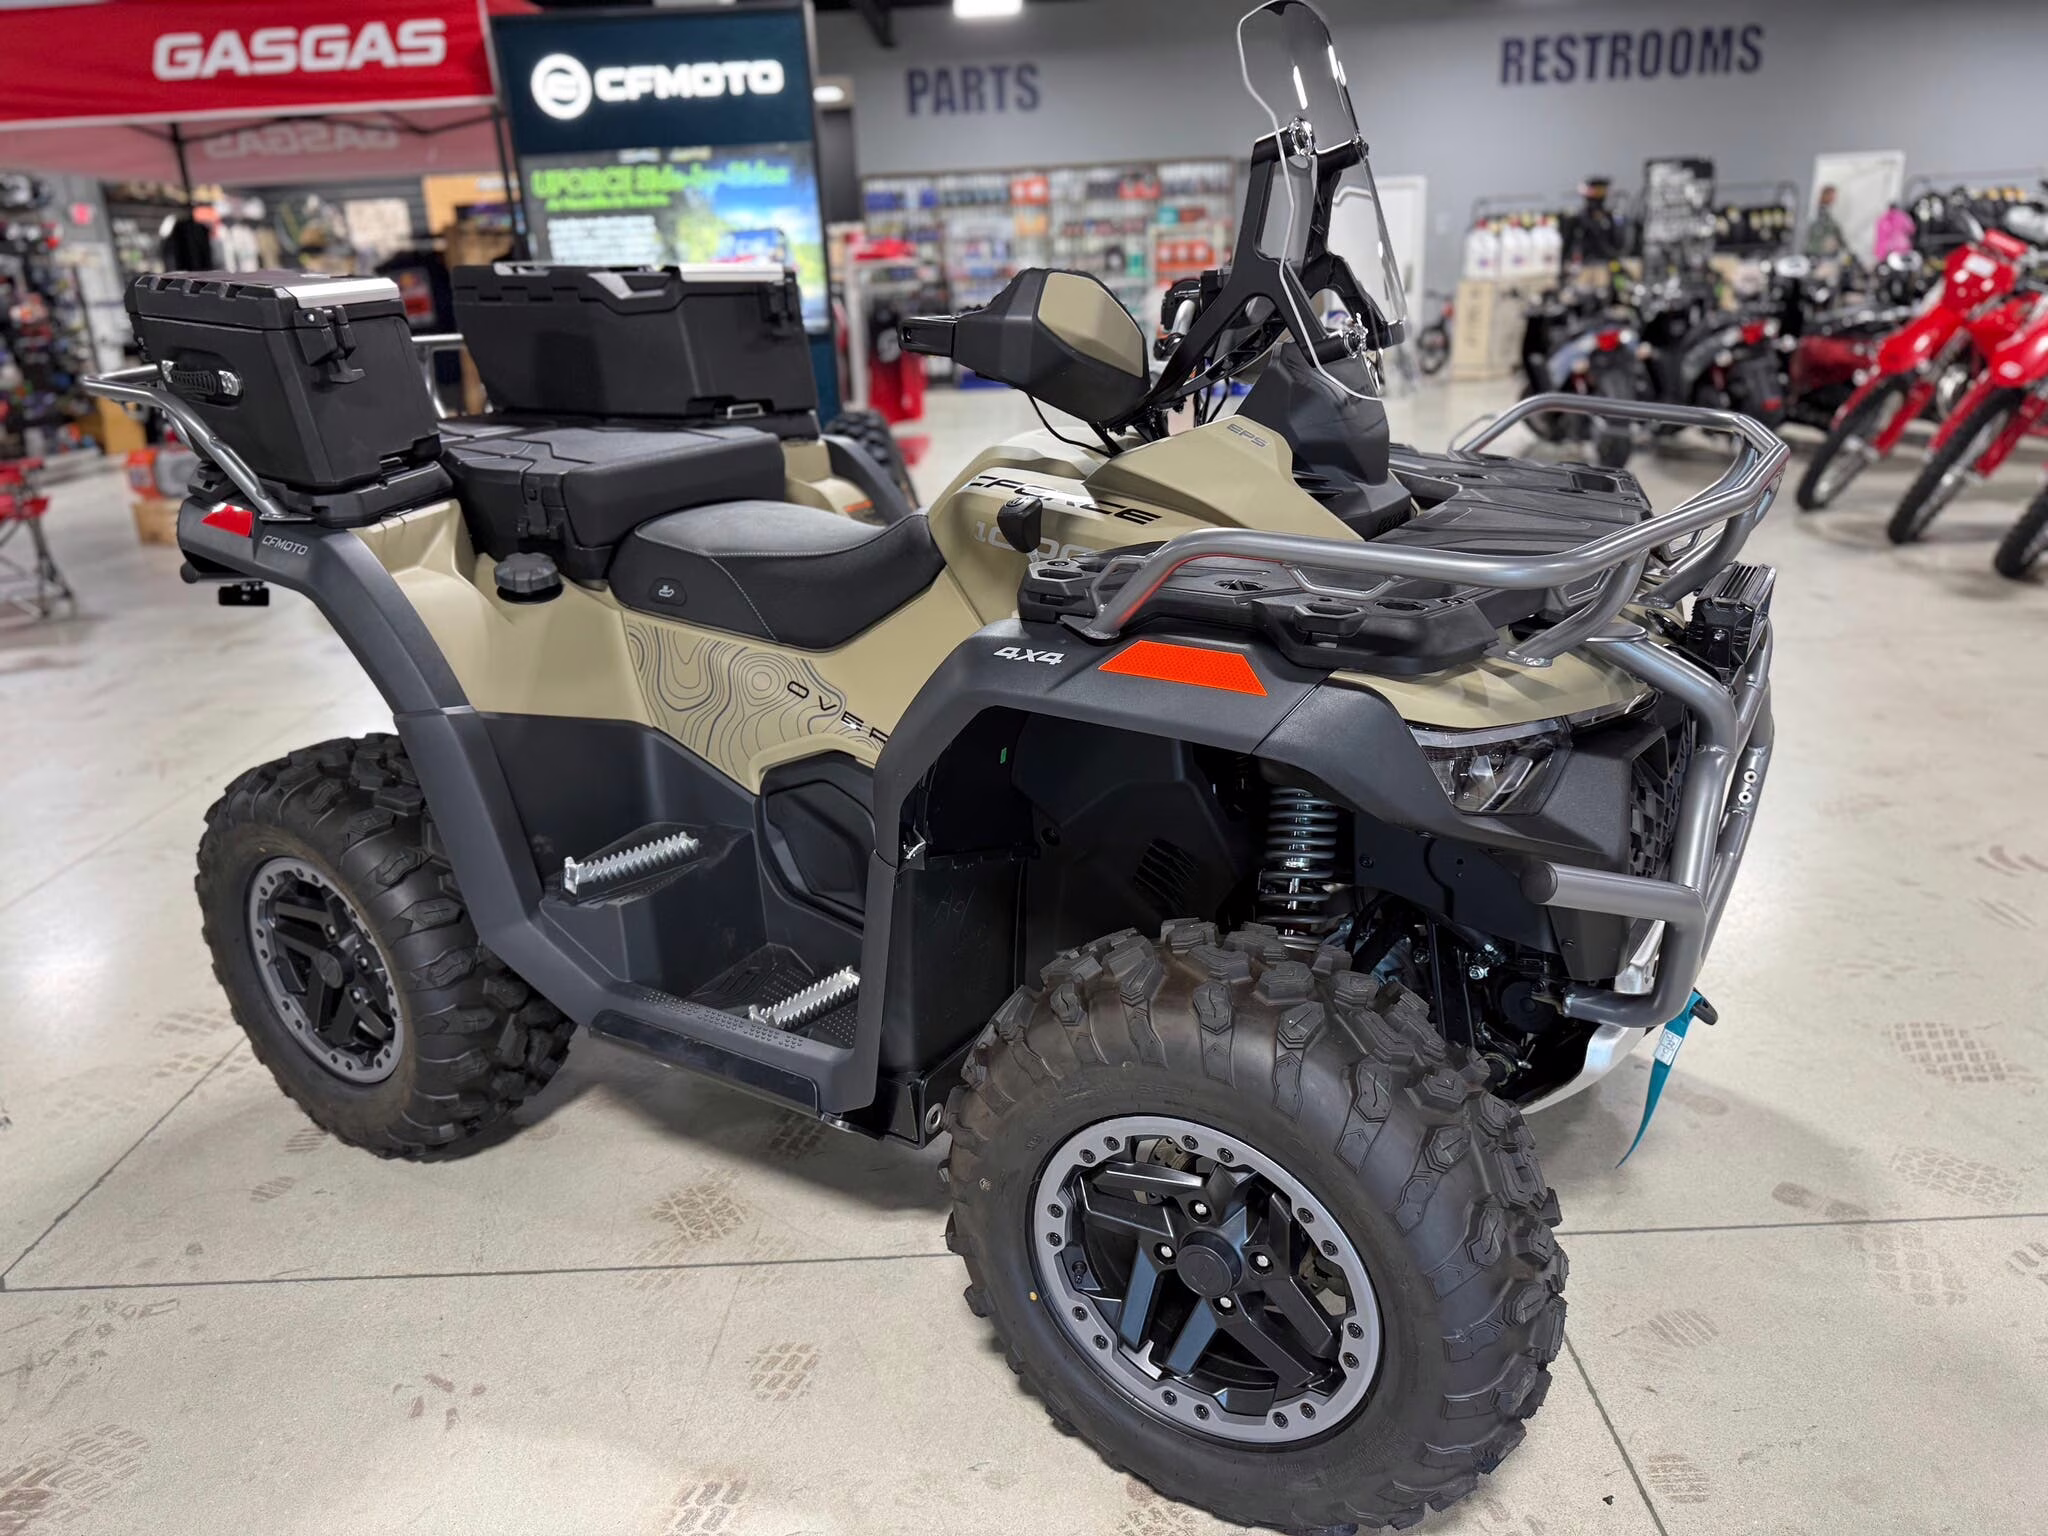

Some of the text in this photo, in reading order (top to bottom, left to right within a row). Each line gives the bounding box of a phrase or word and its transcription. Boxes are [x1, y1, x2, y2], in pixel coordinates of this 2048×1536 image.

[152, 17, 448, 82] GASGAS
[1498, 23, 1764, 86] RESTROOMS
[593, 59, 786, 102] CFMOTO
[905, 62, 1040, 115] PARTS
[1226, 423, 1269, 448] EPS
[963, 475, 1163, 526] CFOCE
[261, 535, 309, 556] CFMOTO
